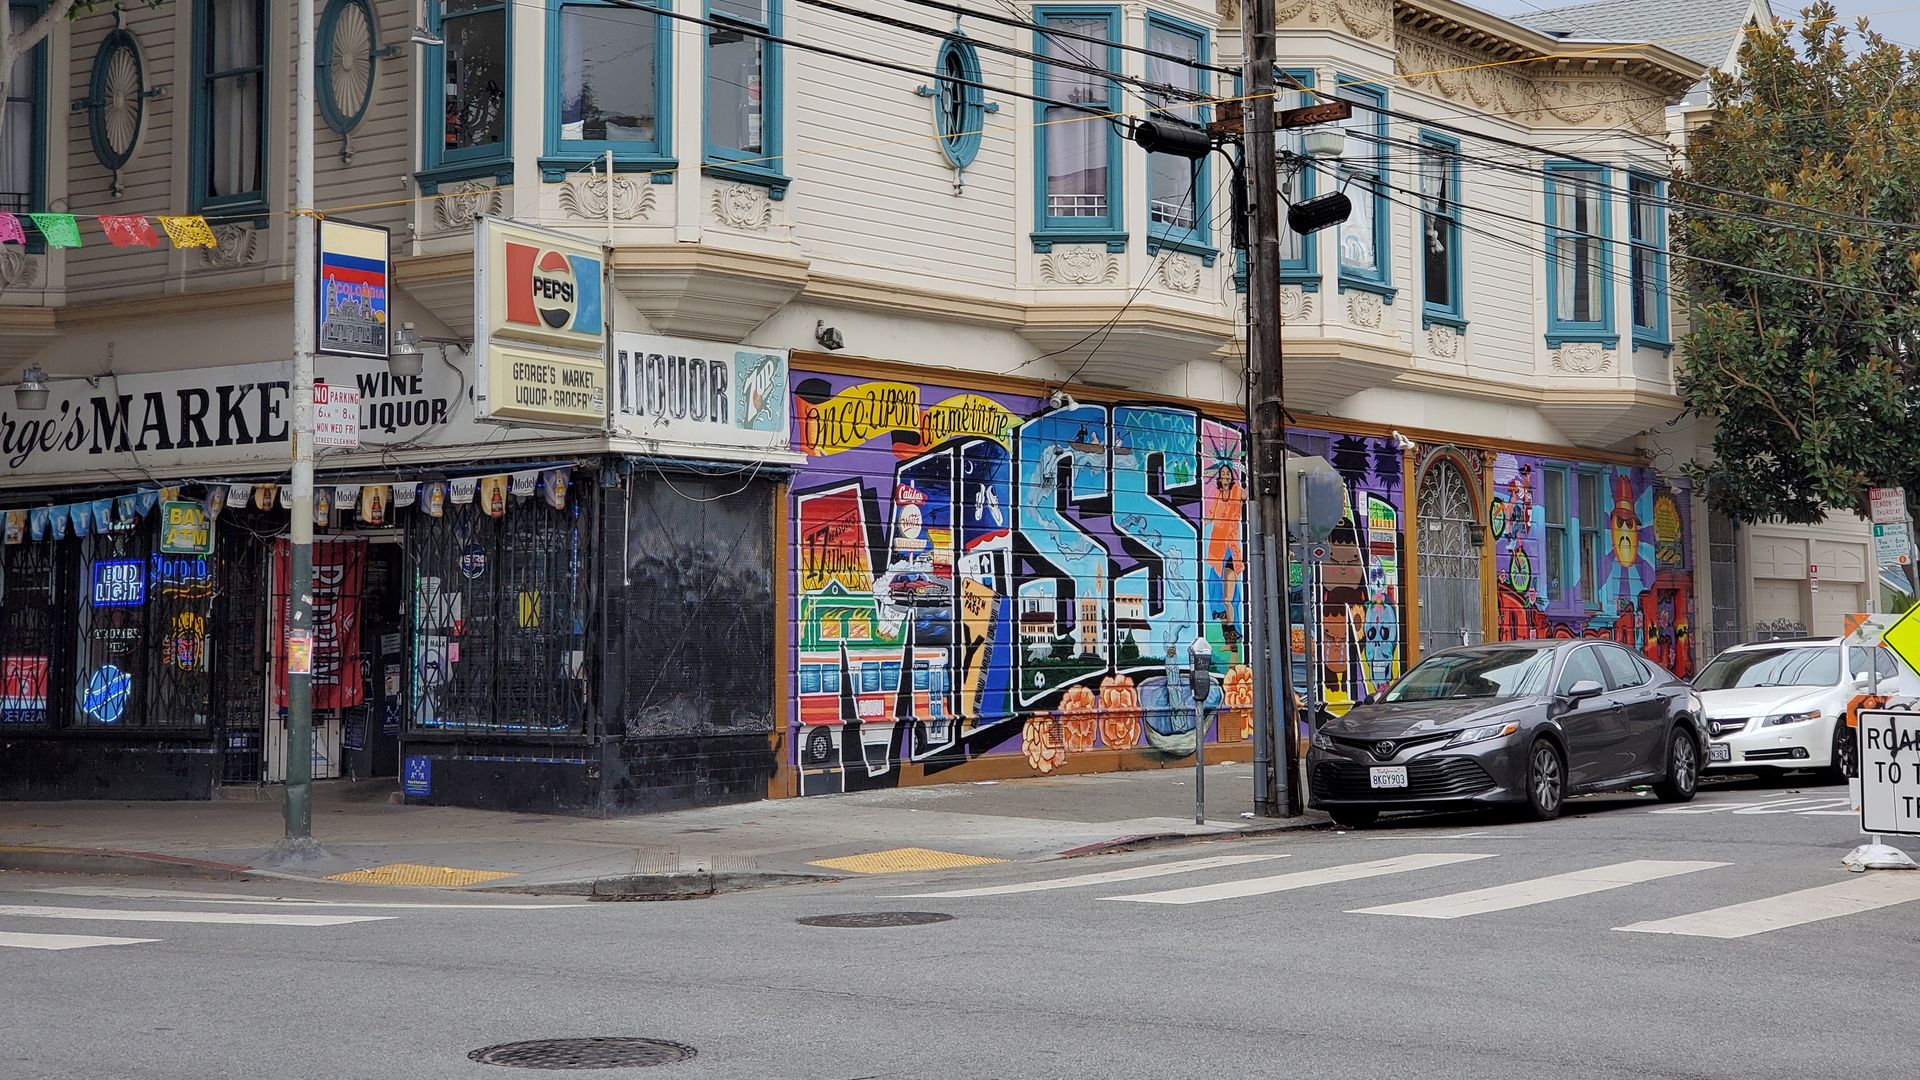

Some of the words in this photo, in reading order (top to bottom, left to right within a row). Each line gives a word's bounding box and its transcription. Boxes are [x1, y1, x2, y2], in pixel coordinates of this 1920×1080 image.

[533, 275, 574, 304] PEPSI
[356, 371, 423, 399] WINE
[513, 362, 556, 385] GEORGE'S
[562, 368, 594, 389] MARKET
[314, 386, 327, 403] NO
[330, 391, 359, 405] PARKING
[516, 385, 547, 407] LIQUOR
[618, 349, 728, 427] LIQUOR
[89, 383, 290, 455] MARKE
[360, 398, 447, 434] LIQUOR
[316, 423, 328, 433] MON
[330, 424, 343, 434] WED
[345, 425, 356, 435] FRI
[1871, 490, 1881, 500] NO
[169, 508, 205, 526] BAY
[166, 528, 208, 546] ATM
[103, 564, 137, 583] BUD
[95, 581, 142, 602] LIGHT
[1373, 774, 1405, 785] 8KGY903
[1874, 761, 1902, 784] TO
